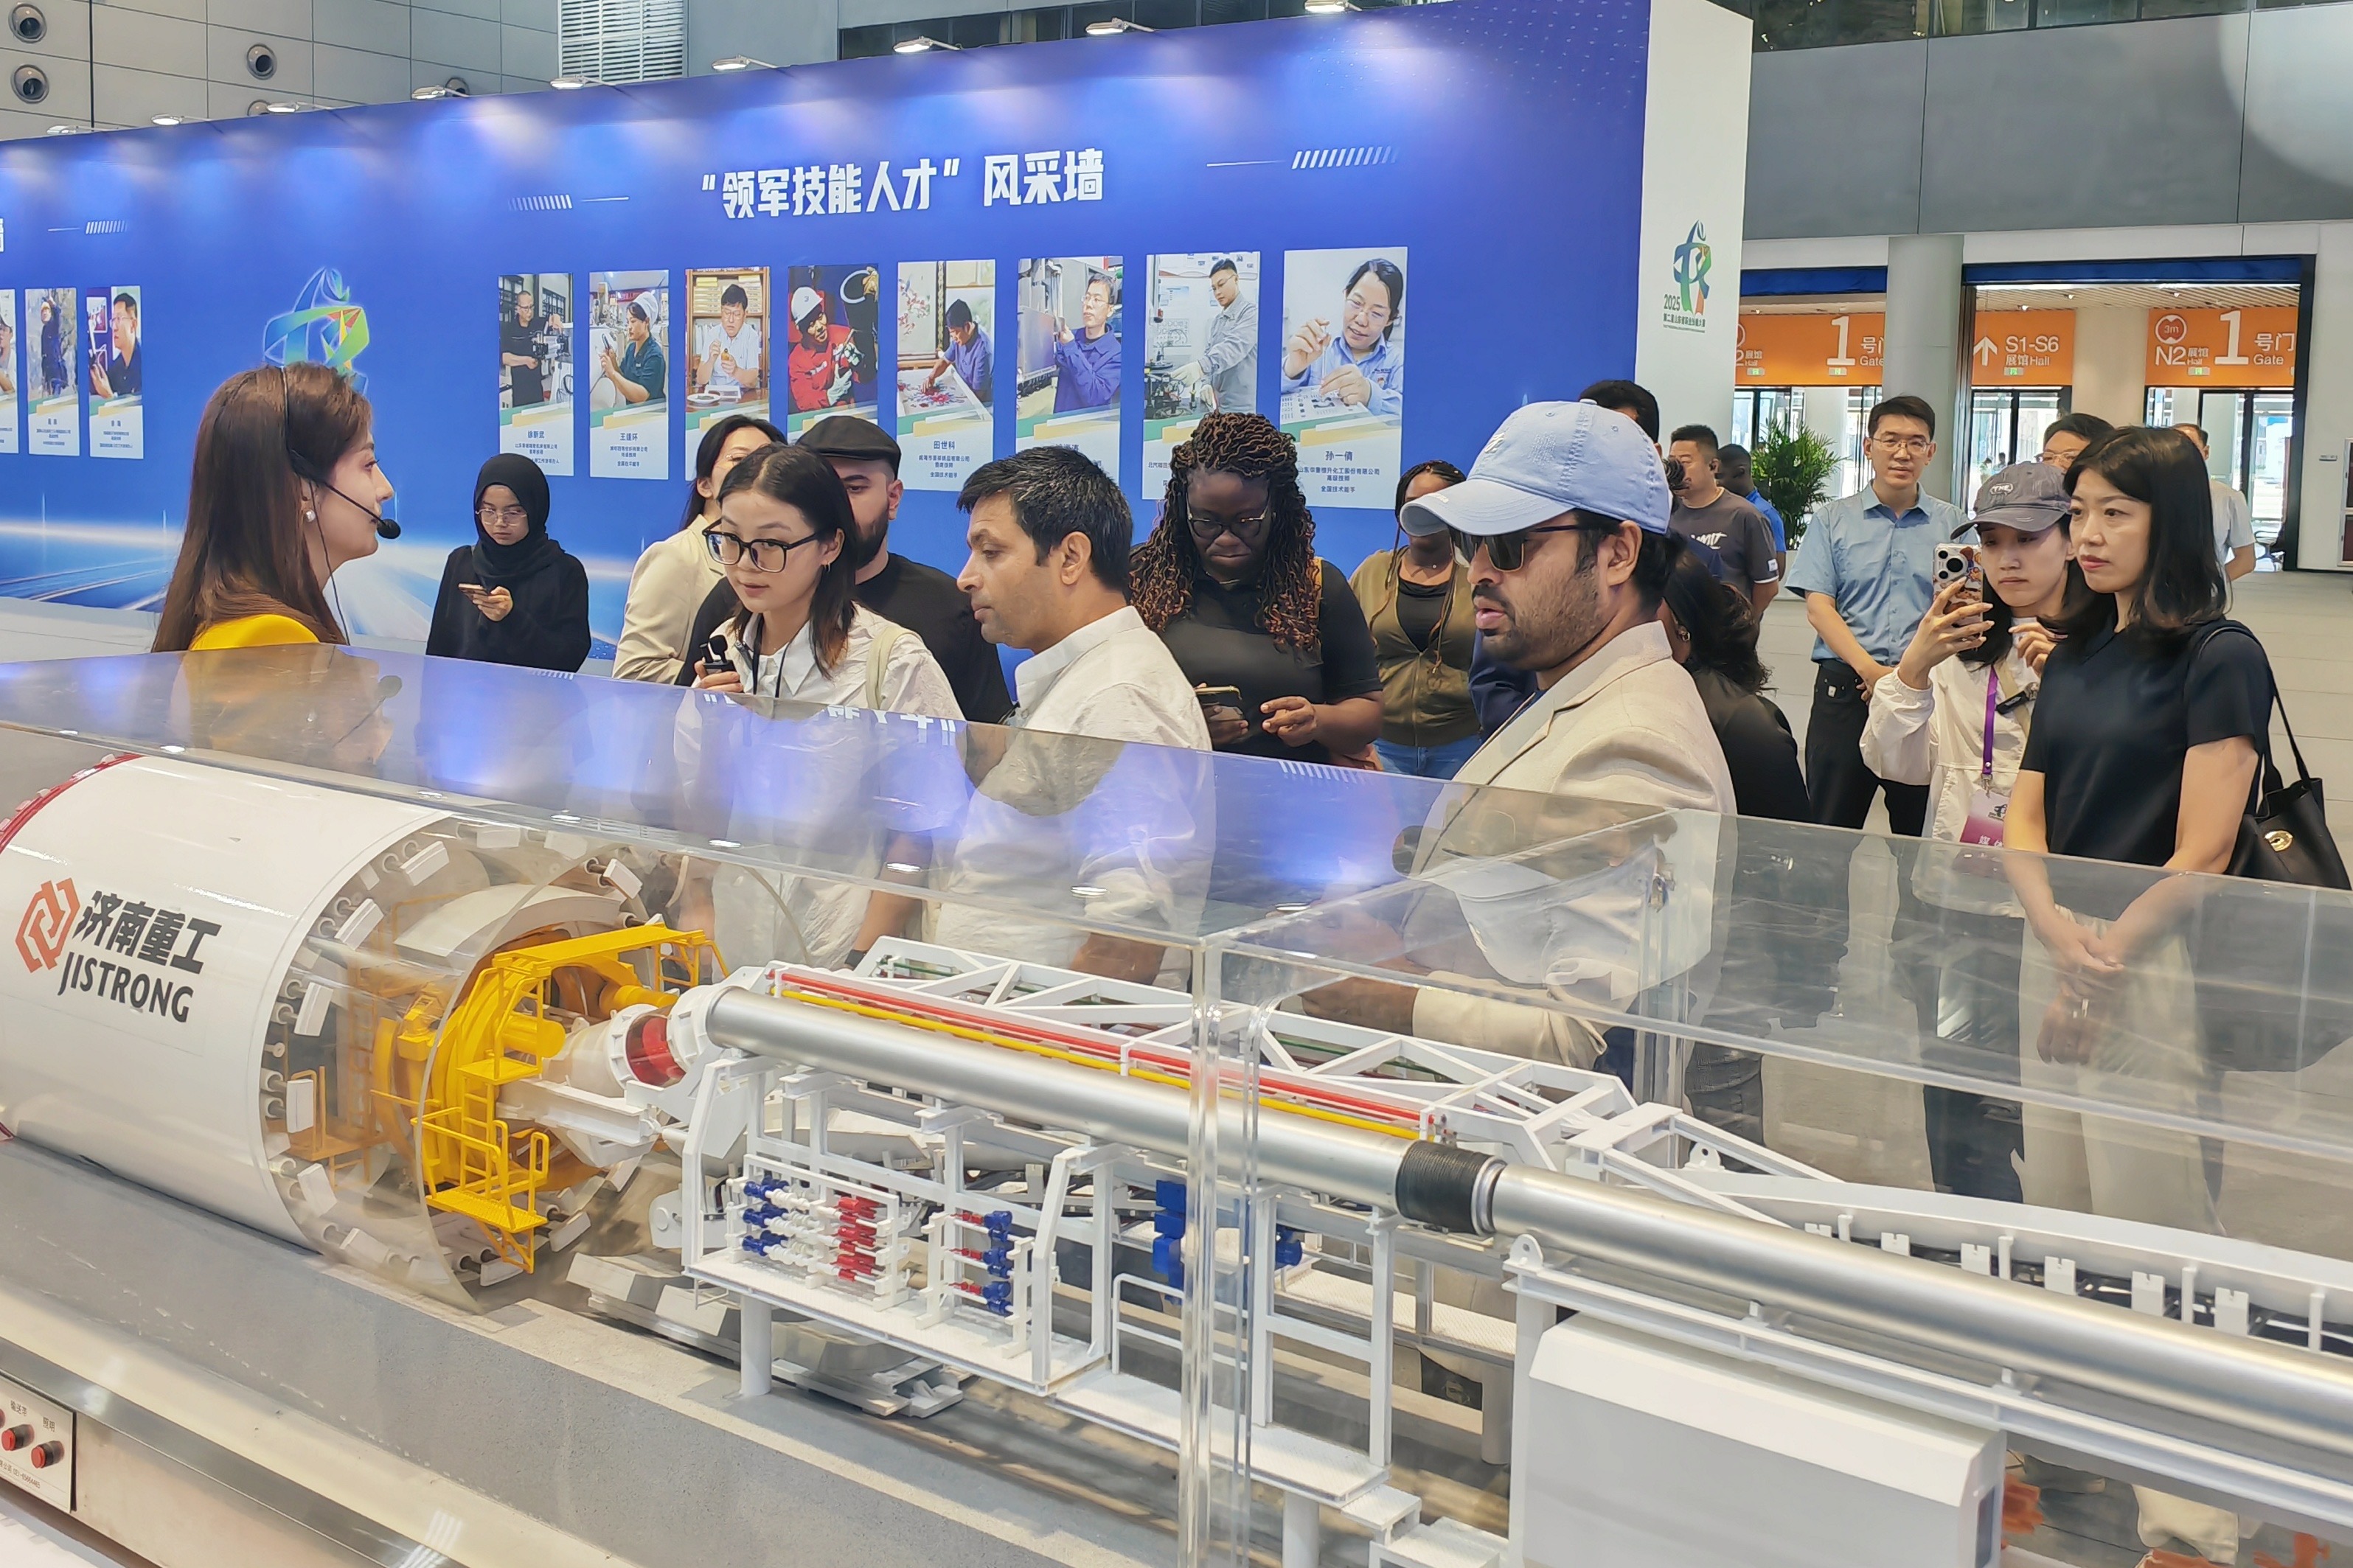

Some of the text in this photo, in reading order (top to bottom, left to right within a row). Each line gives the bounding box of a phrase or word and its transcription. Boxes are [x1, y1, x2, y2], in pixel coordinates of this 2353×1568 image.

[1664, 293, 1681, 311] 2025
[2163, 324, 2179, 334] 3m
[1827, 316, 1855, 366] 1
[2005, 335, 2060, 353] S1-S6
[2214, 310, 2249, 365] 1
[2254, 332, 2295, 352] 号门
[2005, 354, 2050, 366] 展馆 Hall
[2155, 346, 2187, 366] N2
[2188, 347, 2209, 358] 展馆
[2253, 354, 2284, 366] Gate
[2187, 358, 2203, 366] Hall
[934, 440, 955, 450] 田世科
[1321, 485, 1355, 493] 全国技术能手
[72, 891, 222, 975] 济南重工
[58, 952, 194, 1022] JISTRONG
[43, 1417, 55, 1432] 照明
